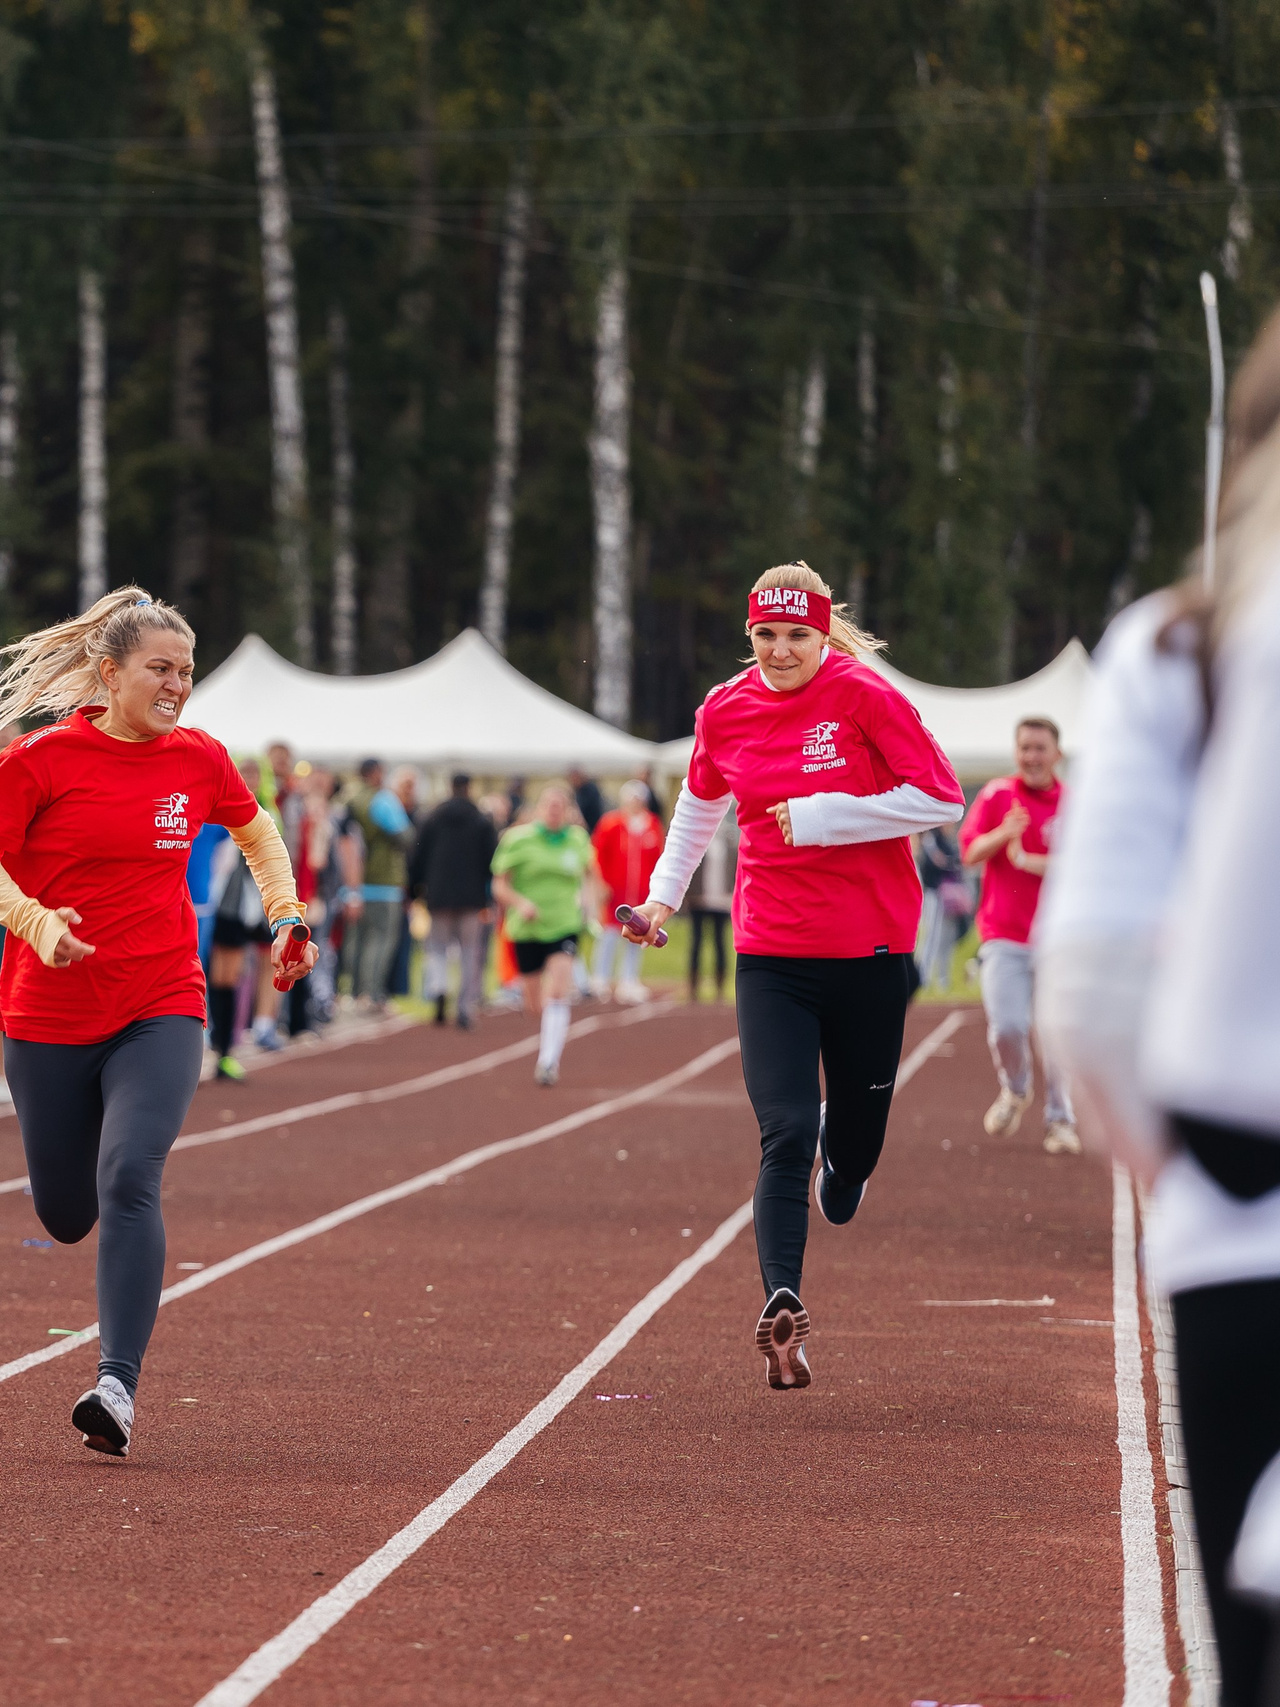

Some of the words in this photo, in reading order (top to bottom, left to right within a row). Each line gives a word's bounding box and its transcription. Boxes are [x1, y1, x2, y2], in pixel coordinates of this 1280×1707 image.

[757, 588, 808, 608] СПАРТА
[785, 605, 808, 617] КИАДА
[802, 743, 836, 756] СПАРТА
[802, 757, 847, 773] СПОРТСМЕН
[154, 816, 188, 829] СПАРТА
[157, 840, 191, 849] СПОРТСМЕ
